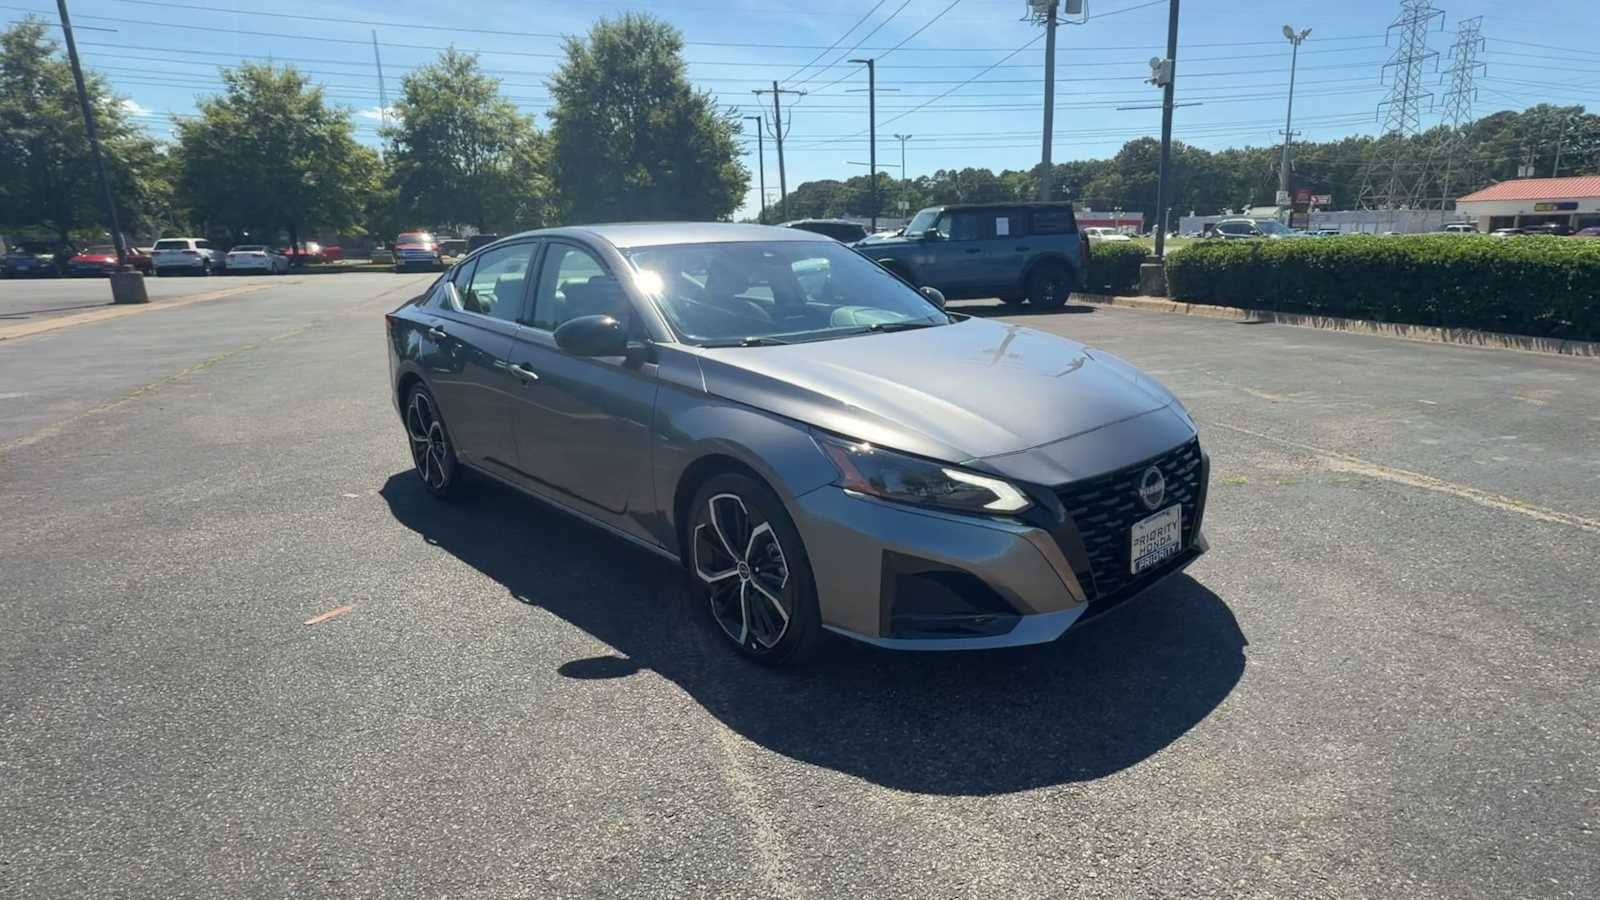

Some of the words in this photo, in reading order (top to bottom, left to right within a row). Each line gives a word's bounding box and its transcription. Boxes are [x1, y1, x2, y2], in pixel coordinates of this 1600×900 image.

[1134, 521, 1177, 546] PRIORITY
[1139, 536, 1171, 556] HONDA
[1139, 545, 1177, 569] PRIORITY
